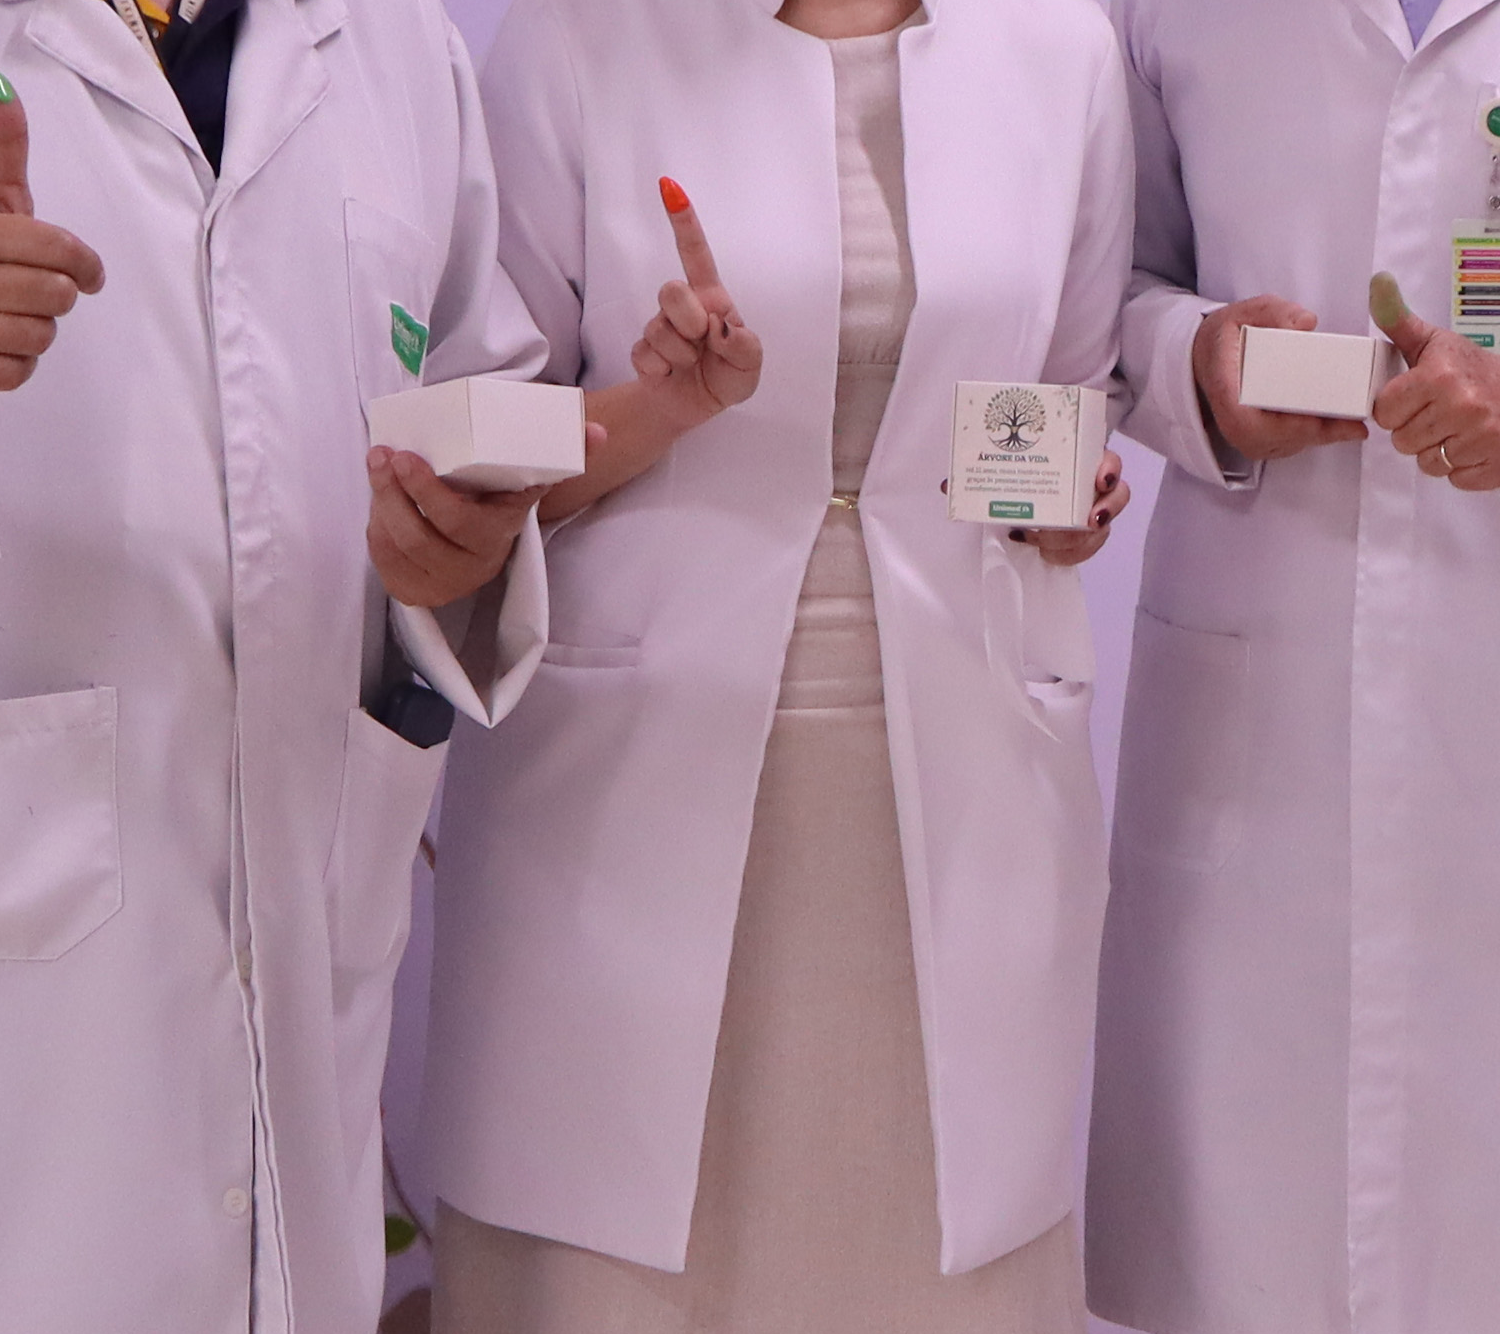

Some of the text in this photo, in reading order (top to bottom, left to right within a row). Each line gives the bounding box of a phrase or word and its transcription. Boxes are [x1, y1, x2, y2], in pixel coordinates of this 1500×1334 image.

[978, 451, 1050, 463] ÁRVORE DA VIDA
[992, 503, 1021, 513] Unimed
